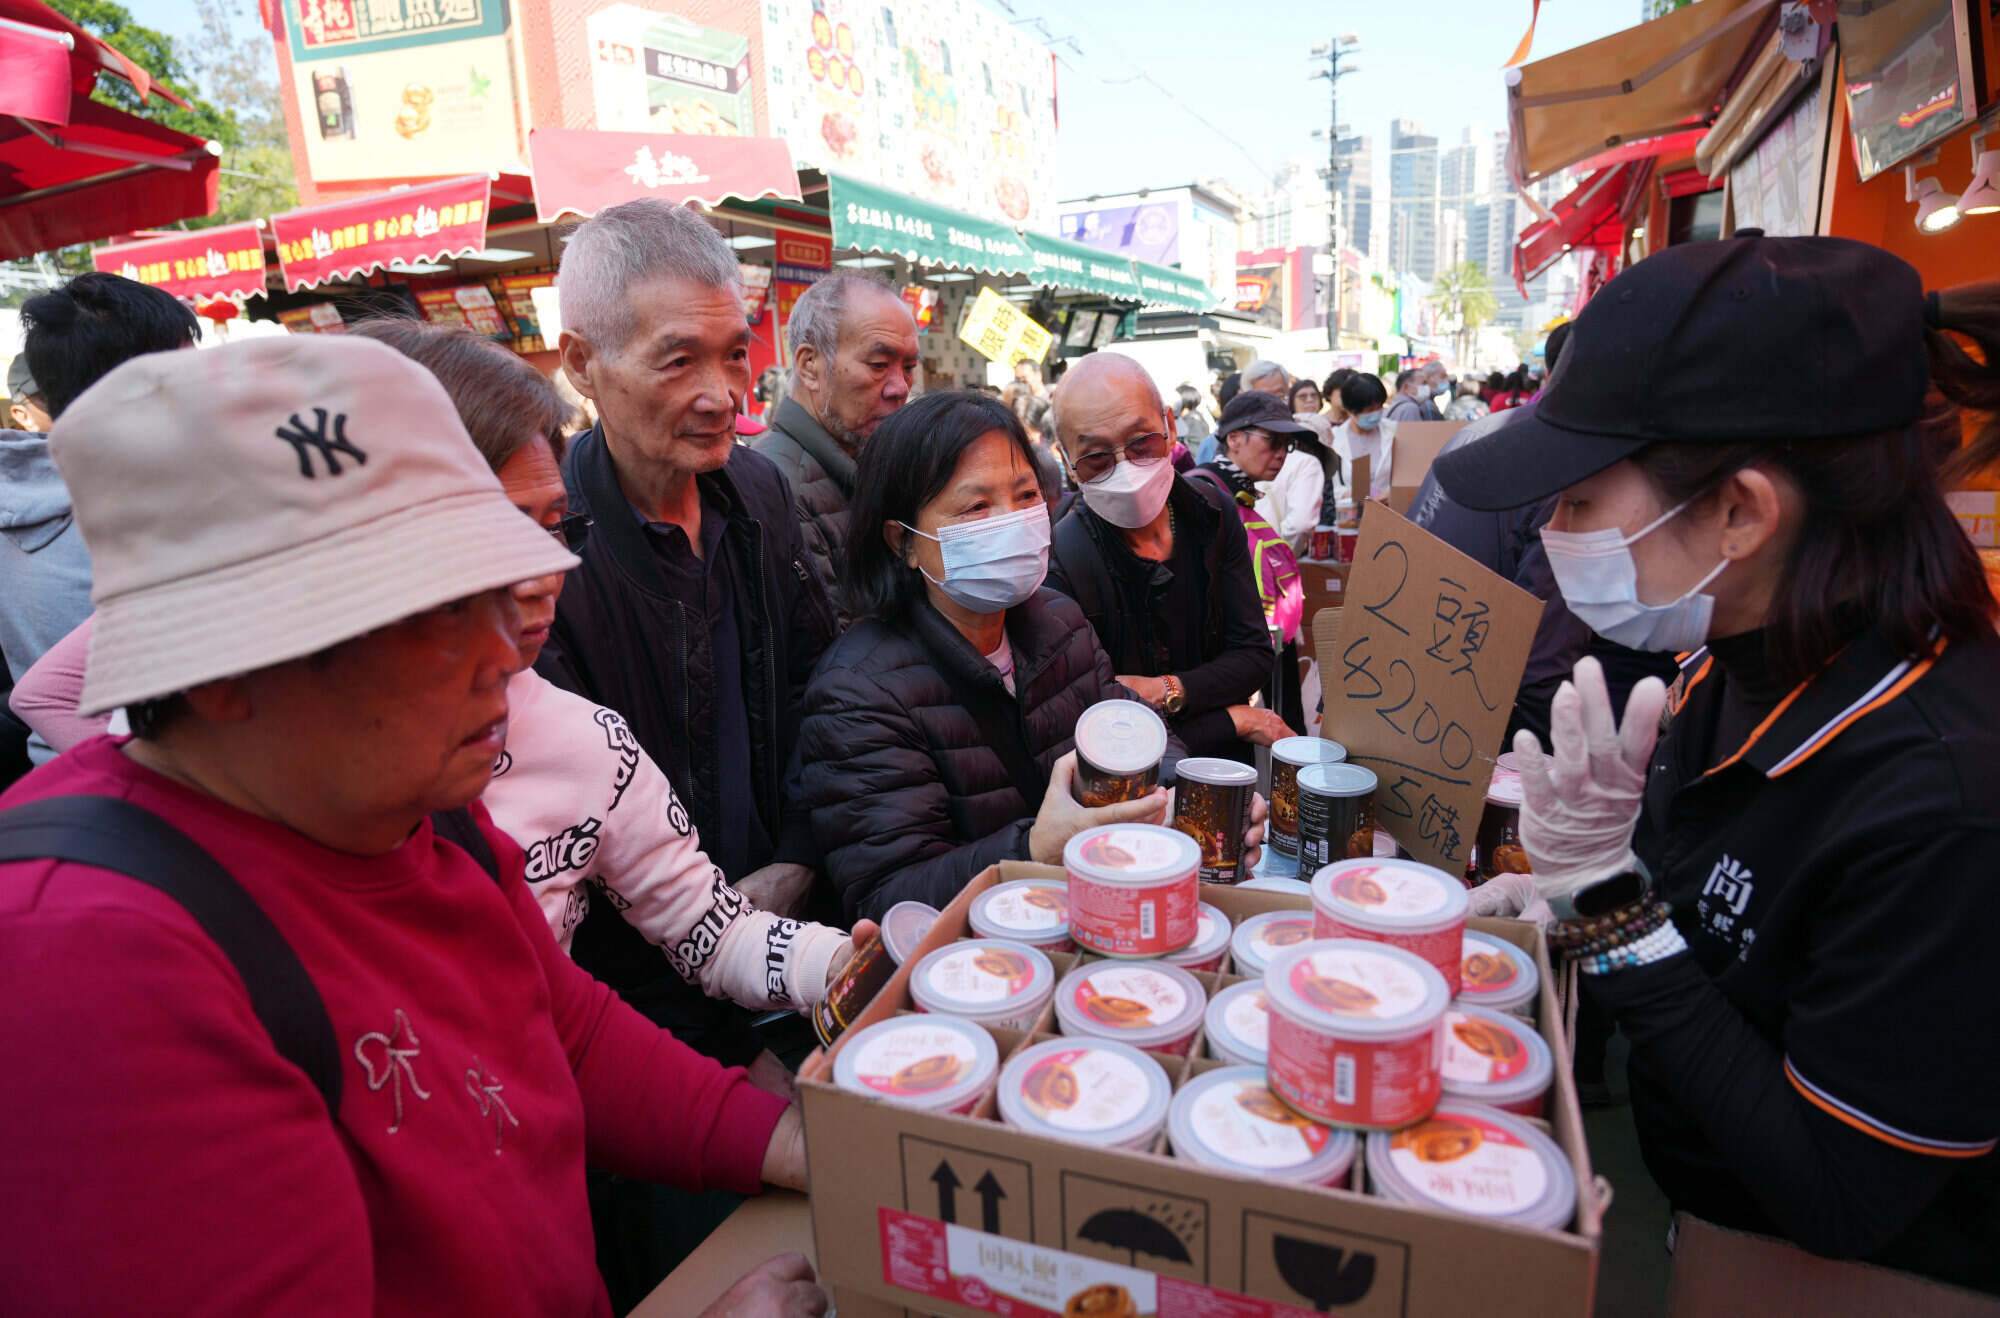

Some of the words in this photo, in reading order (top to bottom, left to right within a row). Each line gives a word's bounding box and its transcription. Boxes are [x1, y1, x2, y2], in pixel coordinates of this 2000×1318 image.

[276, 406, 368, 479] NY
[1343, 636, 1474, 771] $200
[1701, 852, 1755, 916] 尚
